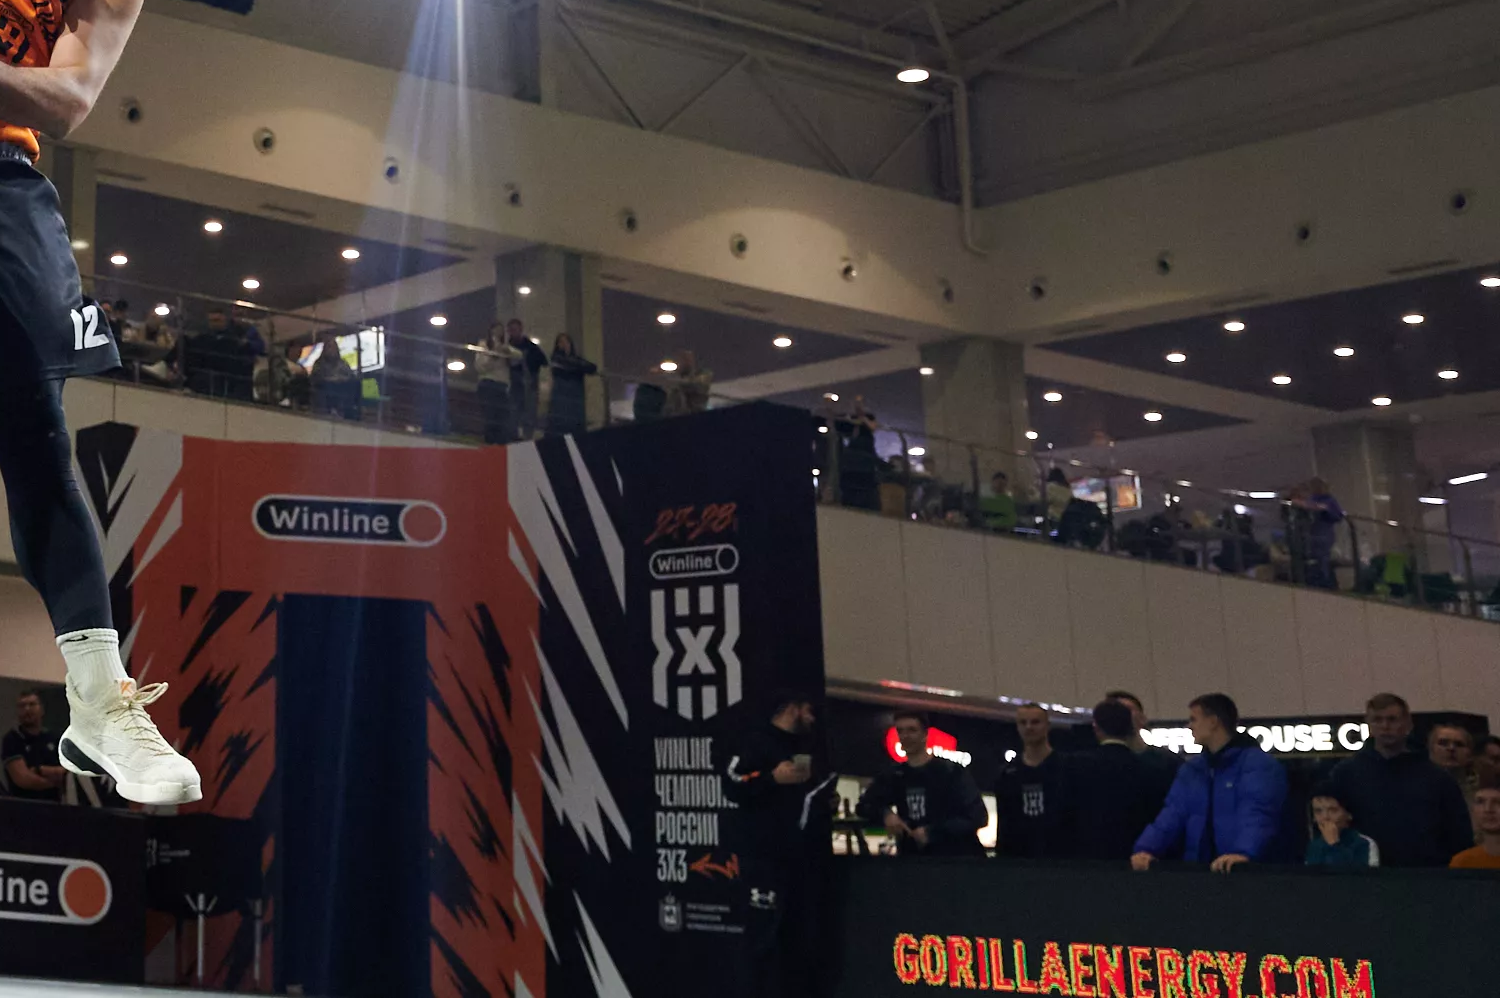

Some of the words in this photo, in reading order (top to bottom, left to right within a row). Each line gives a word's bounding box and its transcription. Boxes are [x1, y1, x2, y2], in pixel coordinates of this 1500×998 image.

[69, 304, 110, 351] 12
[269, 505, 391, 535] Winline
[656, 554, 713, 572] Winline
[653, 737, 714, 770] WINLINE
[1237, 724, 1334, 753] OUSE
[654, 775, 740, 809] ЧЕМПИО
[655, 811, 720, 846] РОССИИ
[893, 932, 1376, 998] GORILLAENERGY.COM
